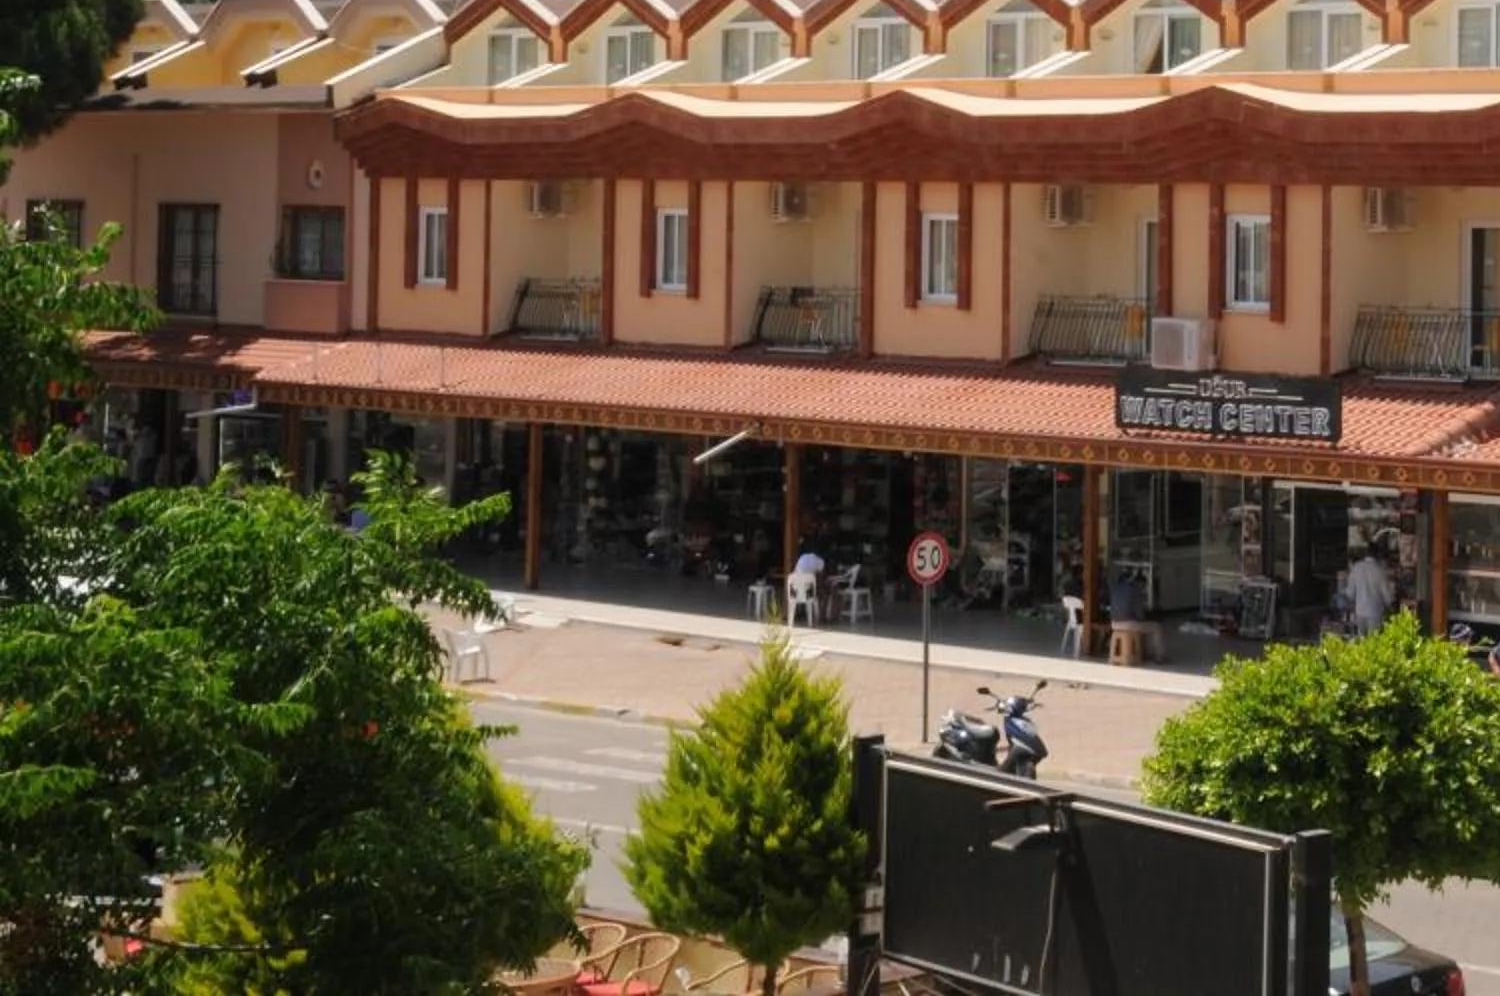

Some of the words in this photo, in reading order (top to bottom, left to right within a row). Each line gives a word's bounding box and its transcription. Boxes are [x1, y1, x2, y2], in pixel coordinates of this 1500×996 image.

[1119, 395, 1213, 430] WATCH
[1219, 401, 1331, 436] CENTER
[917, 546, 940, 572] 50
